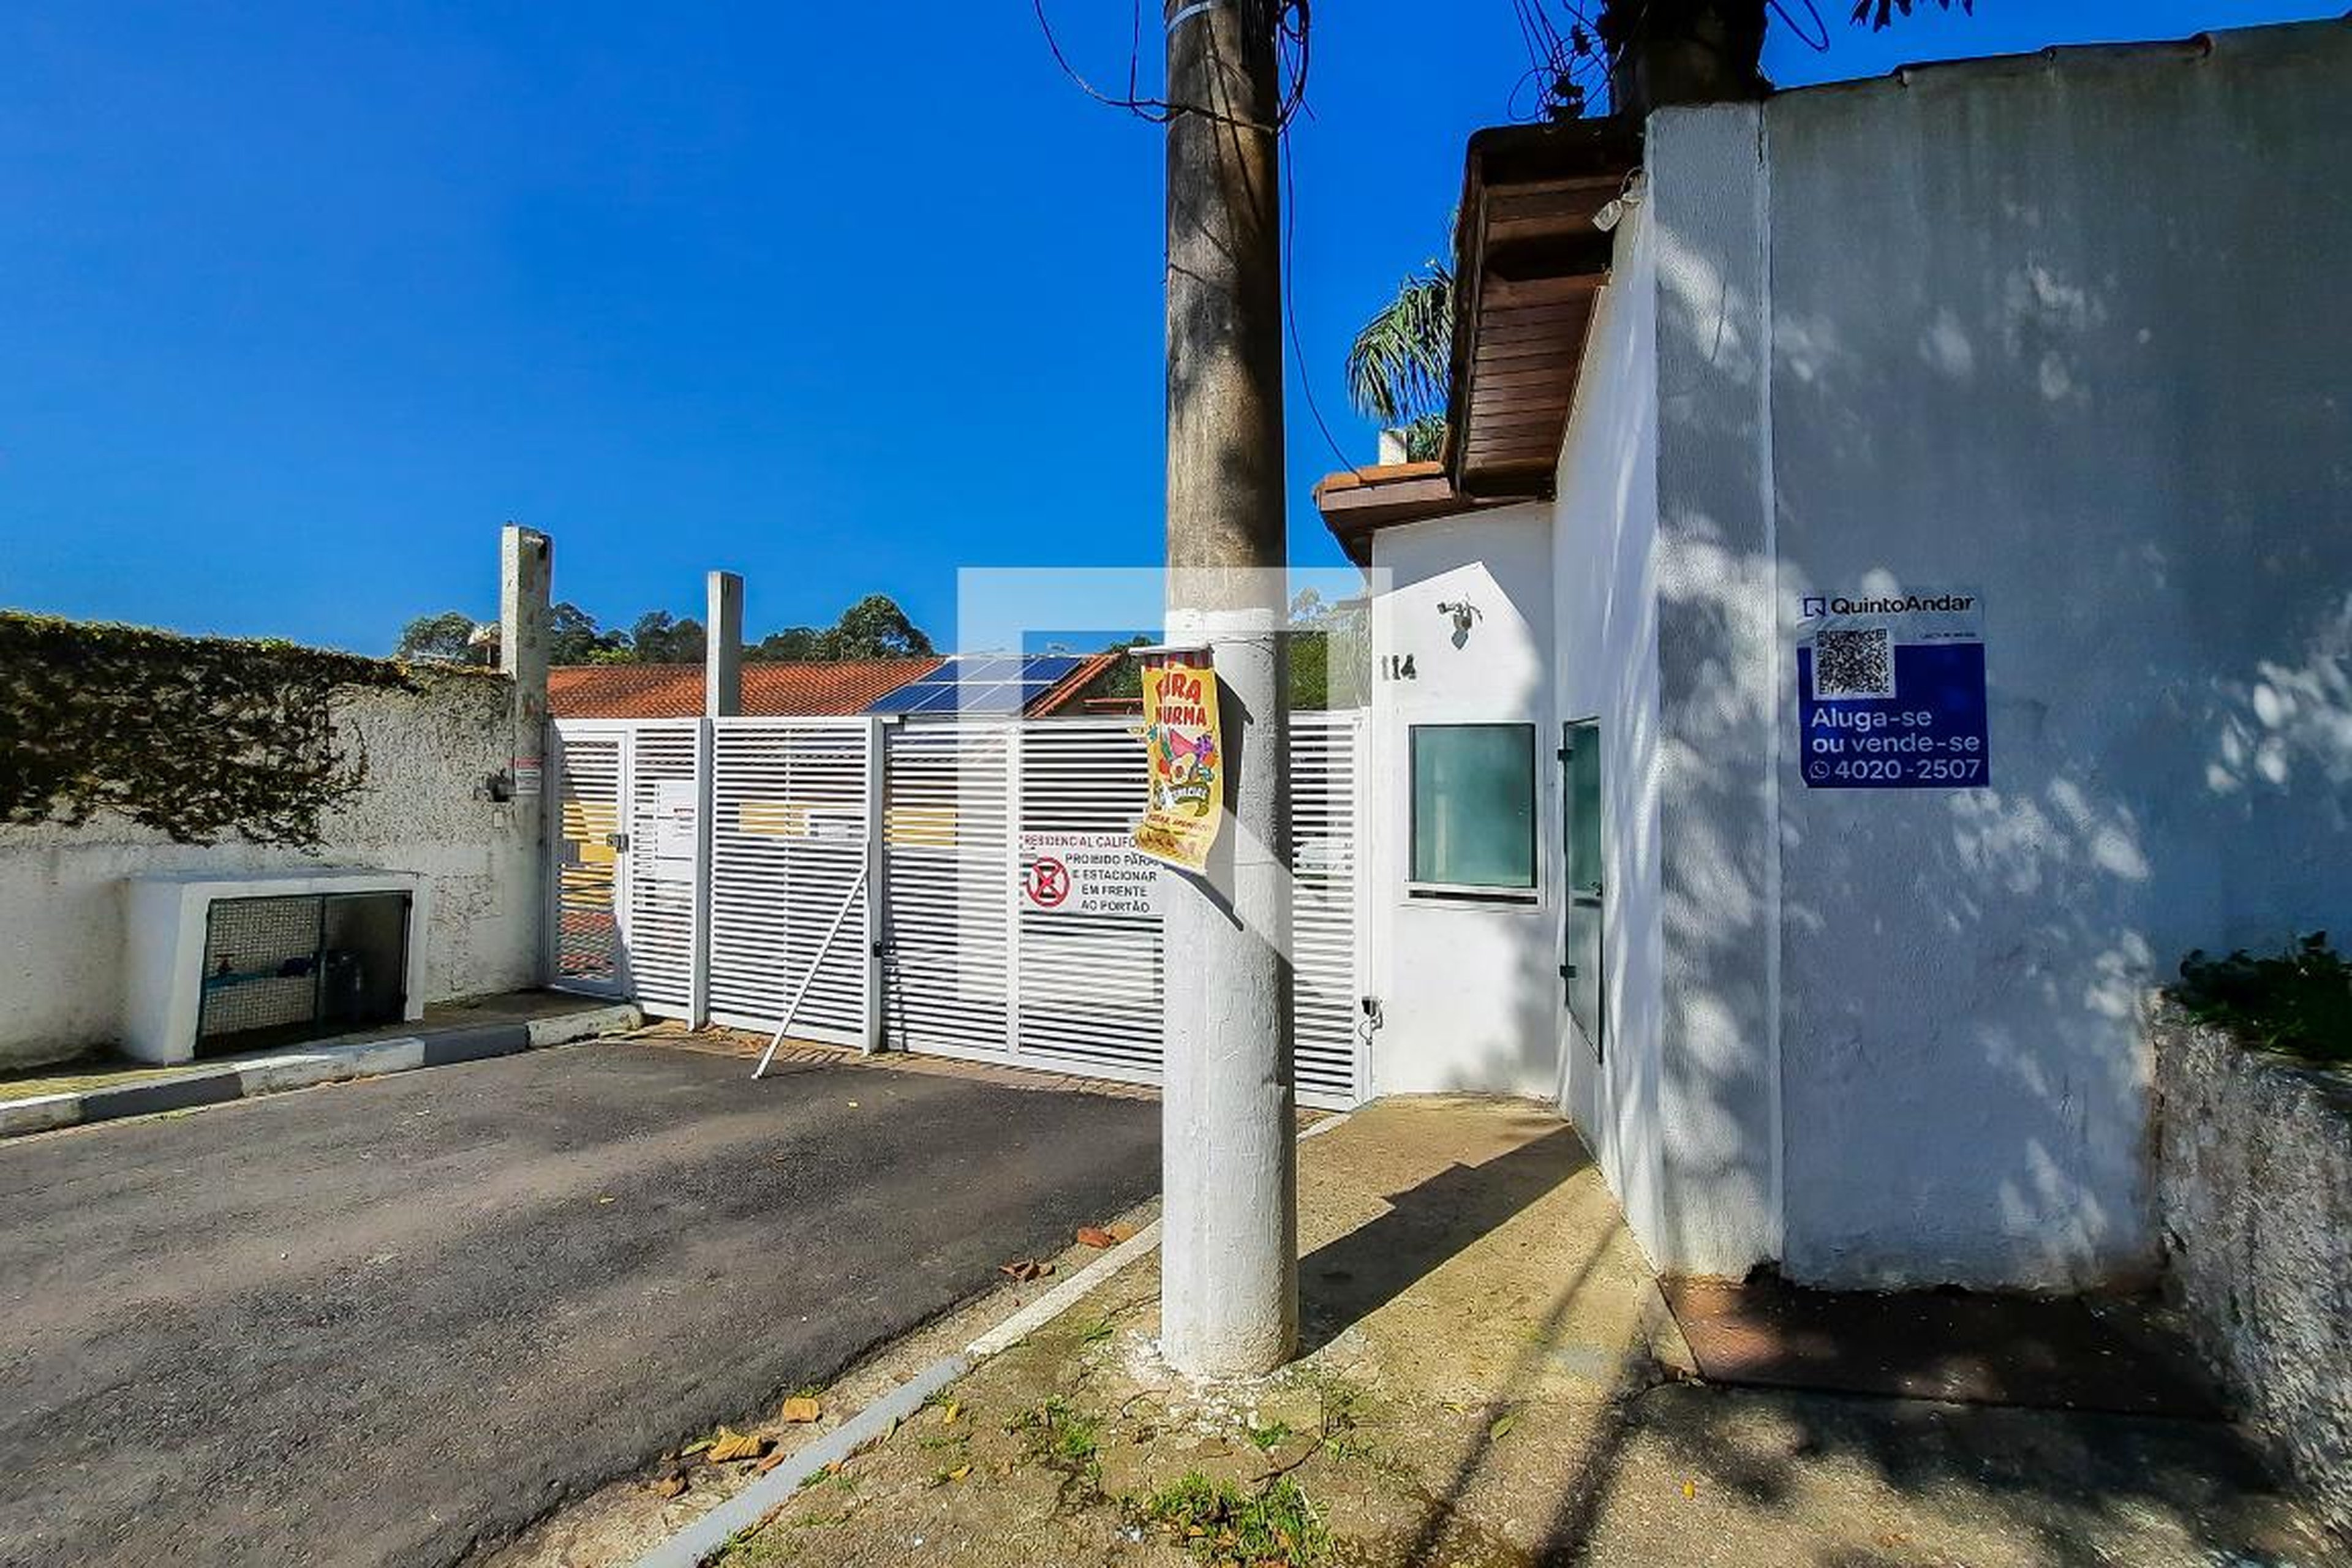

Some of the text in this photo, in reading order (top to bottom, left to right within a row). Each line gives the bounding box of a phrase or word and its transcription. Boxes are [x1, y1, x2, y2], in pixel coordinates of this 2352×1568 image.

[1831, 595, 1975, 614] QuintoAndar
[1811, 708, 1932, 732] Aluga-se
[1812, 733, 1980, 753] ou vende-se
[1834, 759, 1981, 779] 4020-2507
[1024, 834, 1093, 848] RESIDENCAL
[1096, 835, 1139, 848] CALIFO
[1065, 854, 1120, 864] PROIBIDO
[1082, 869, 1157, 881] ESTACIONAR
[1082, 884, 1148, 897] EM FRENTE
[1081, 899, 1150, 913] AO PORTÃO
